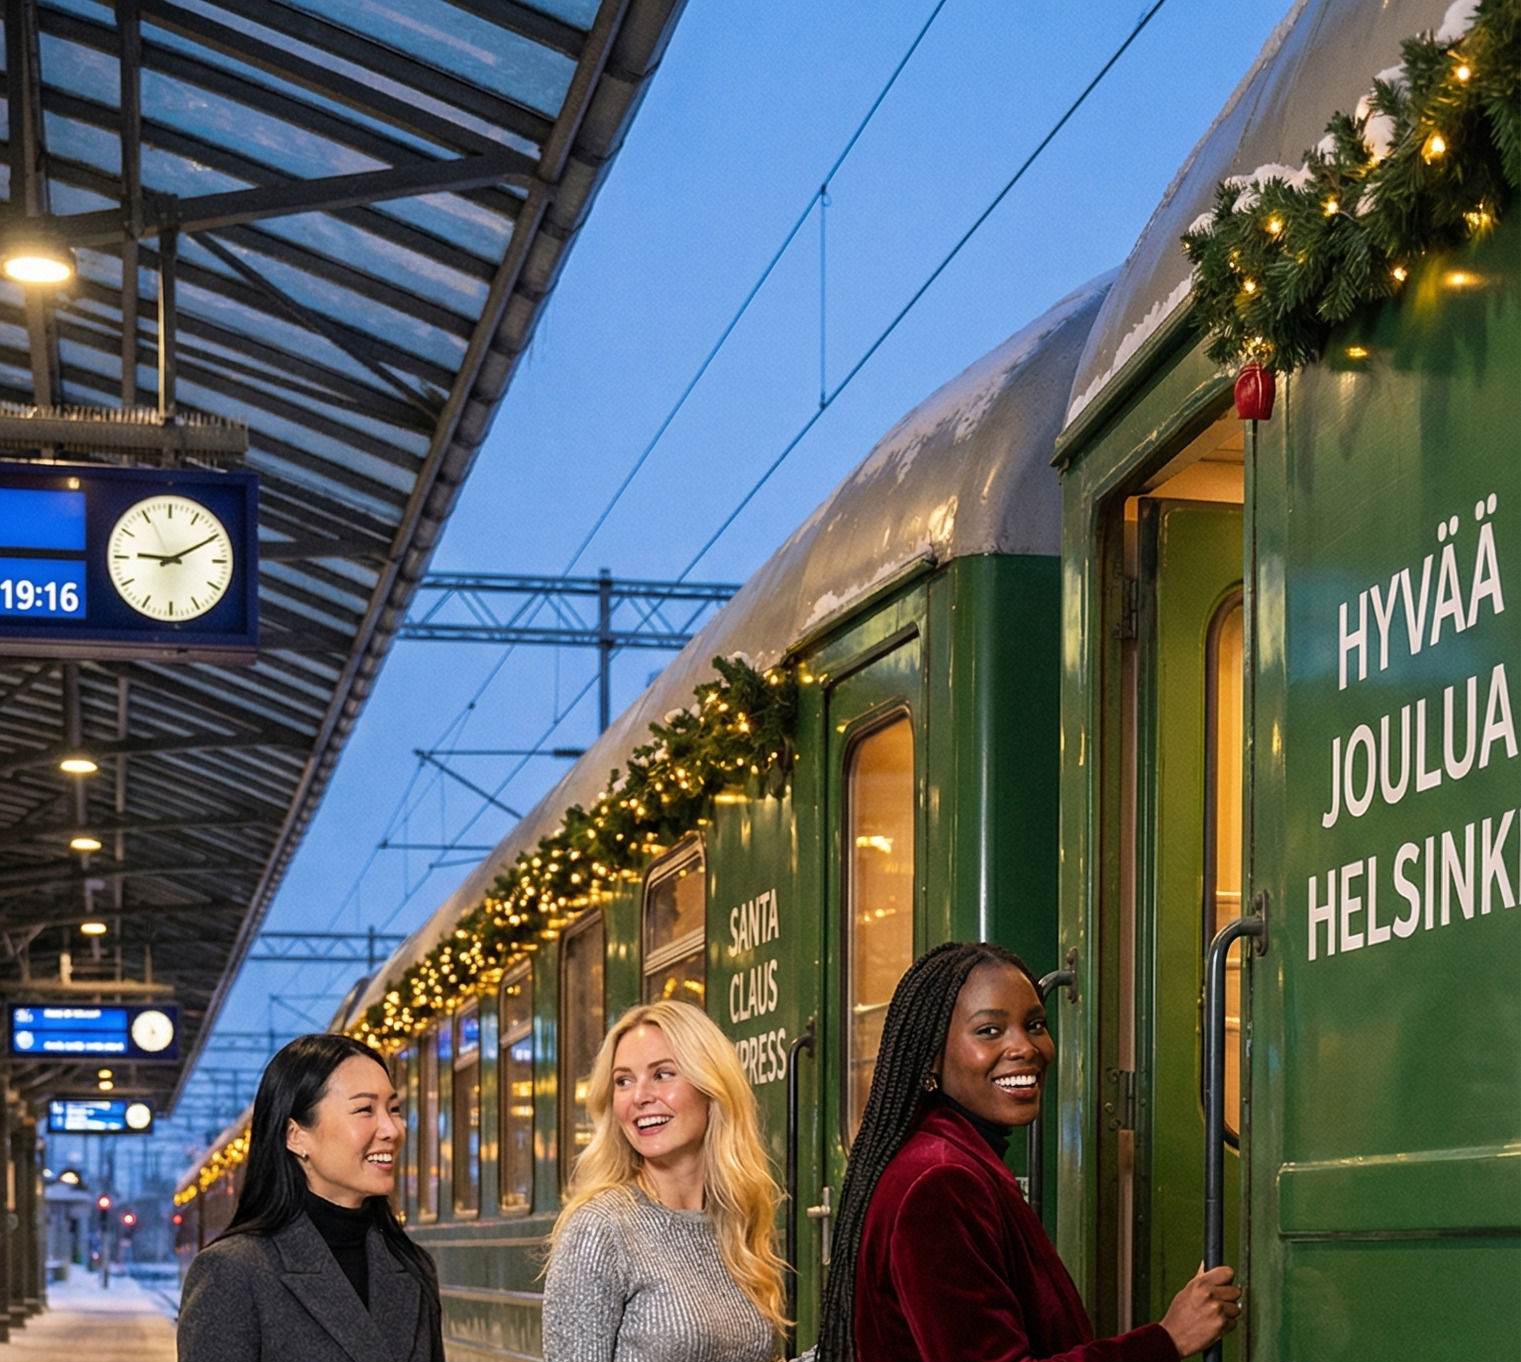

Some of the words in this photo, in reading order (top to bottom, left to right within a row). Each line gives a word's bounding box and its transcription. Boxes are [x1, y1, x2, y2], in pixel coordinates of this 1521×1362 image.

[0, 579, 79, 612] 19:16
[1339, 493, 1505, 691] HYVÄÄ
[1322, 663, 1518, 828] JOULUA
[1308, 808, 1521, 962] HELSINK
[728, 888, 780, 957] SANTA
[729, 959, 778, 1024] CLAUS
[735, 1027, 787, 1085] PRESS
